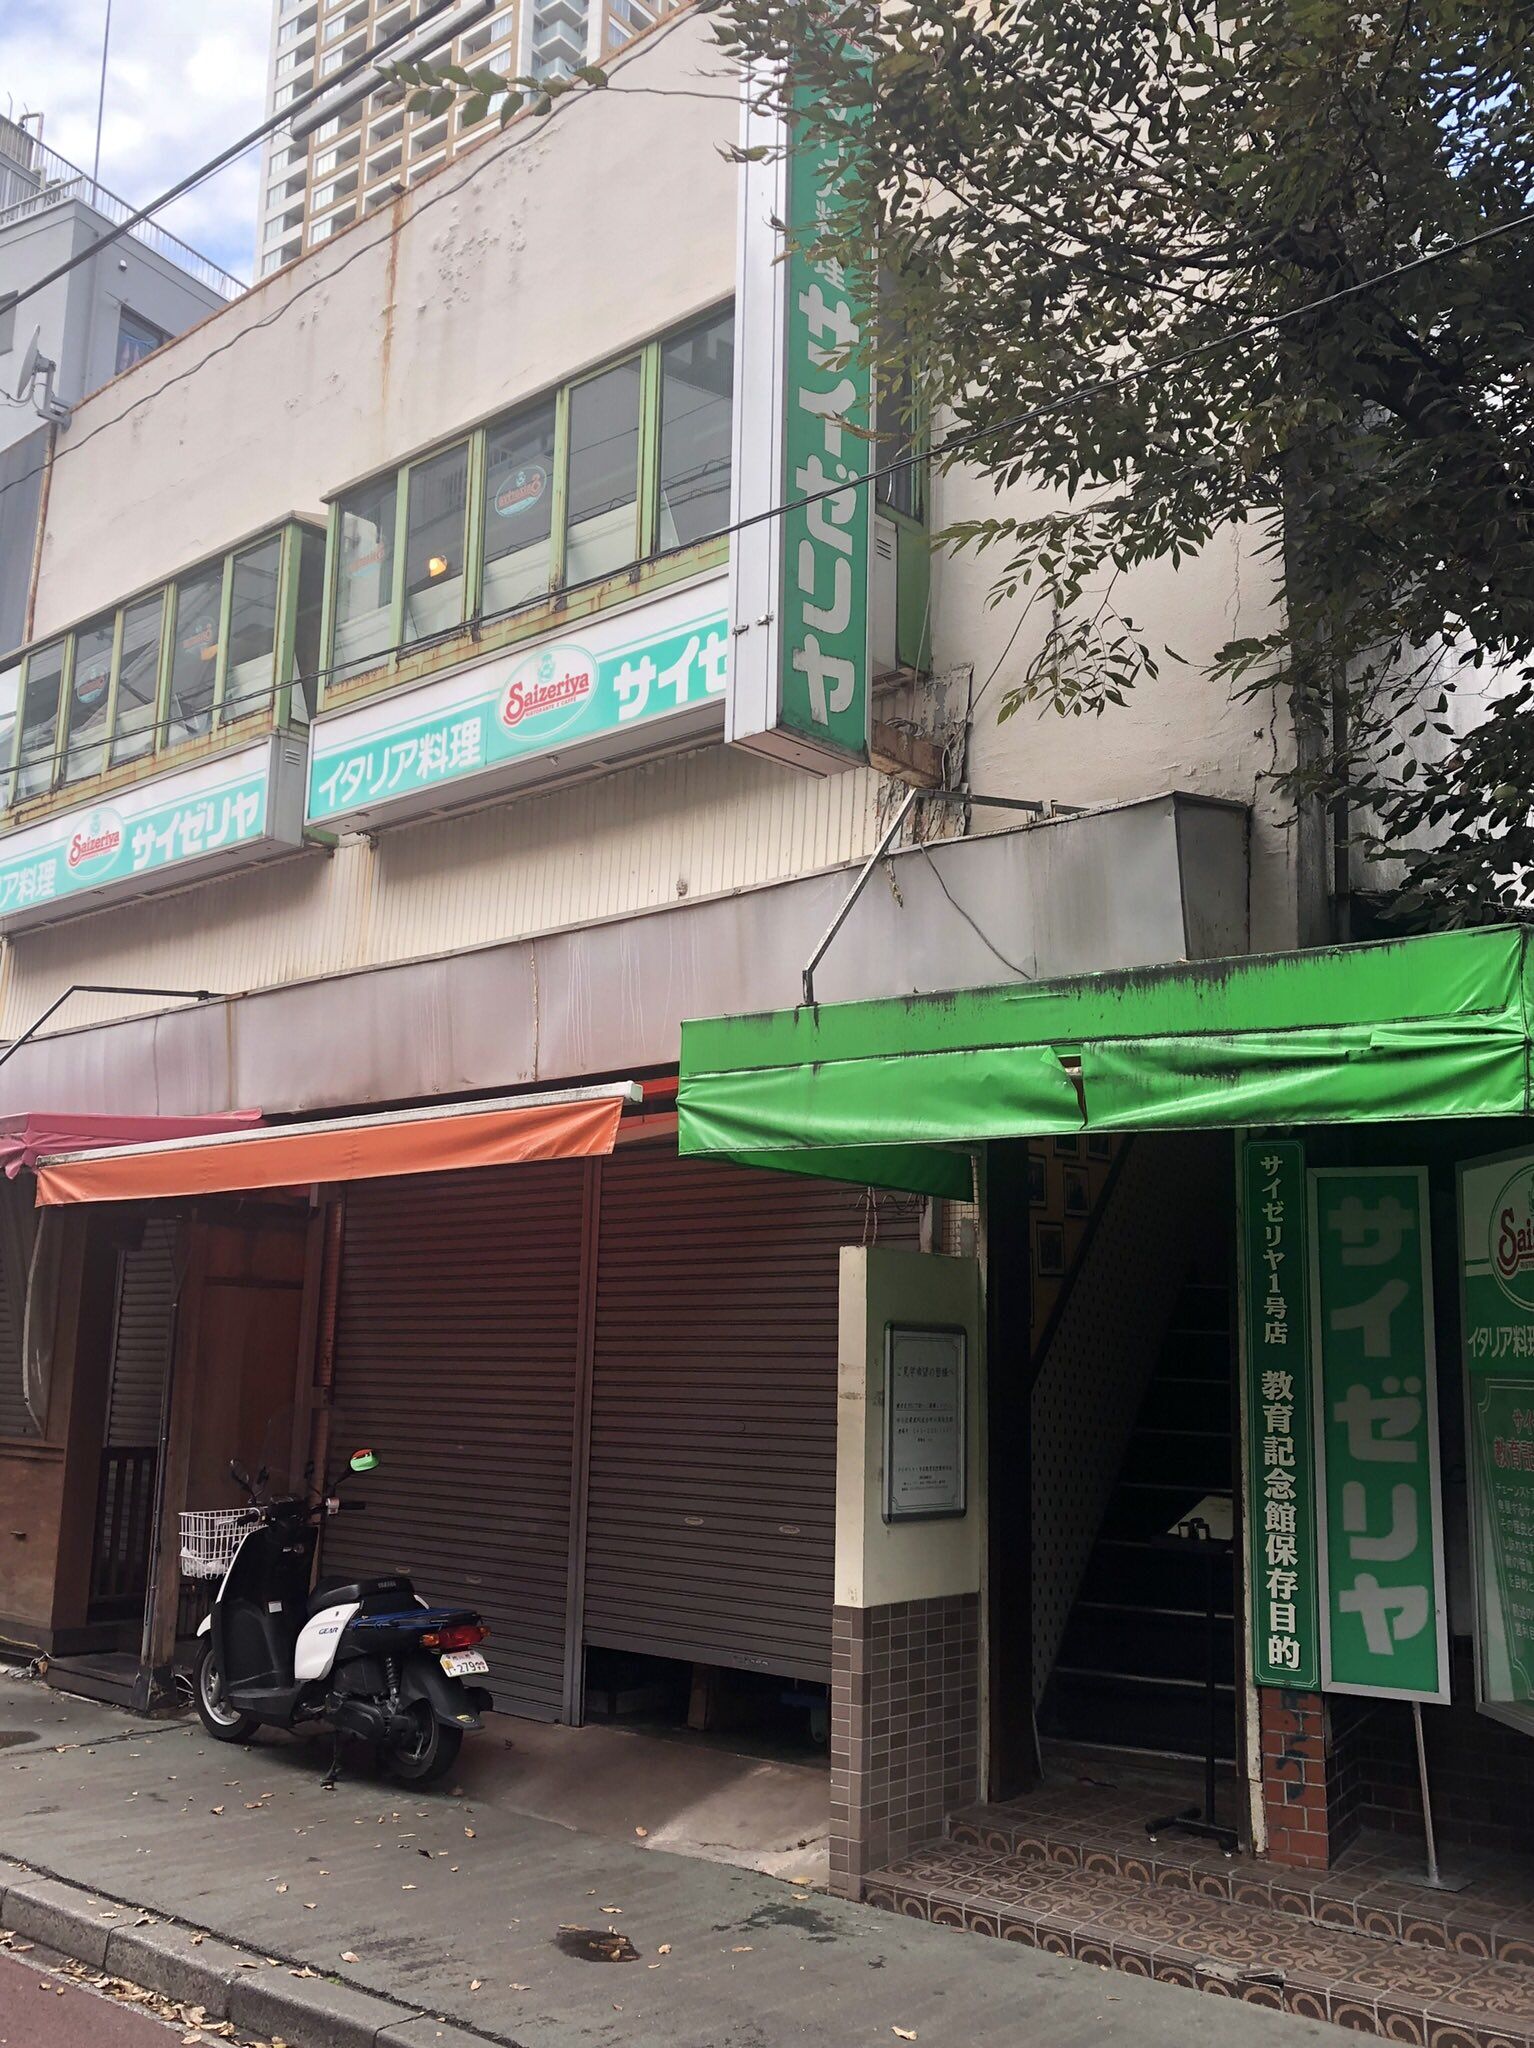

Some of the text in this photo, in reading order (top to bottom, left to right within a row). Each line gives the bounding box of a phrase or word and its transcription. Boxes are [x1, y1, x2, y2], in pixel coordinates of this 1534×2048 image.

[793, 284, 857, 725] サイゼリヤ
[503, 673, 589, 725] Saizeriya
[318, 716, 482, 807] イタリア料理
[69, 830, 119, 866] Saizeriya
[132, 792, 260, 871] サイゼリヤ
[0, 858, 56, 908] ア料理
[1260, 1155, 1288, 1345] サイゼリヤ1号店
[1496, 1206, 1534, 1275] Sai
[1327, 1195, 1430, 1656] サイゼリヤ
[1261, 1370, 1301, 1670] 教育記念館保存目的
[319, 1627, 338, 1635] GEAR
